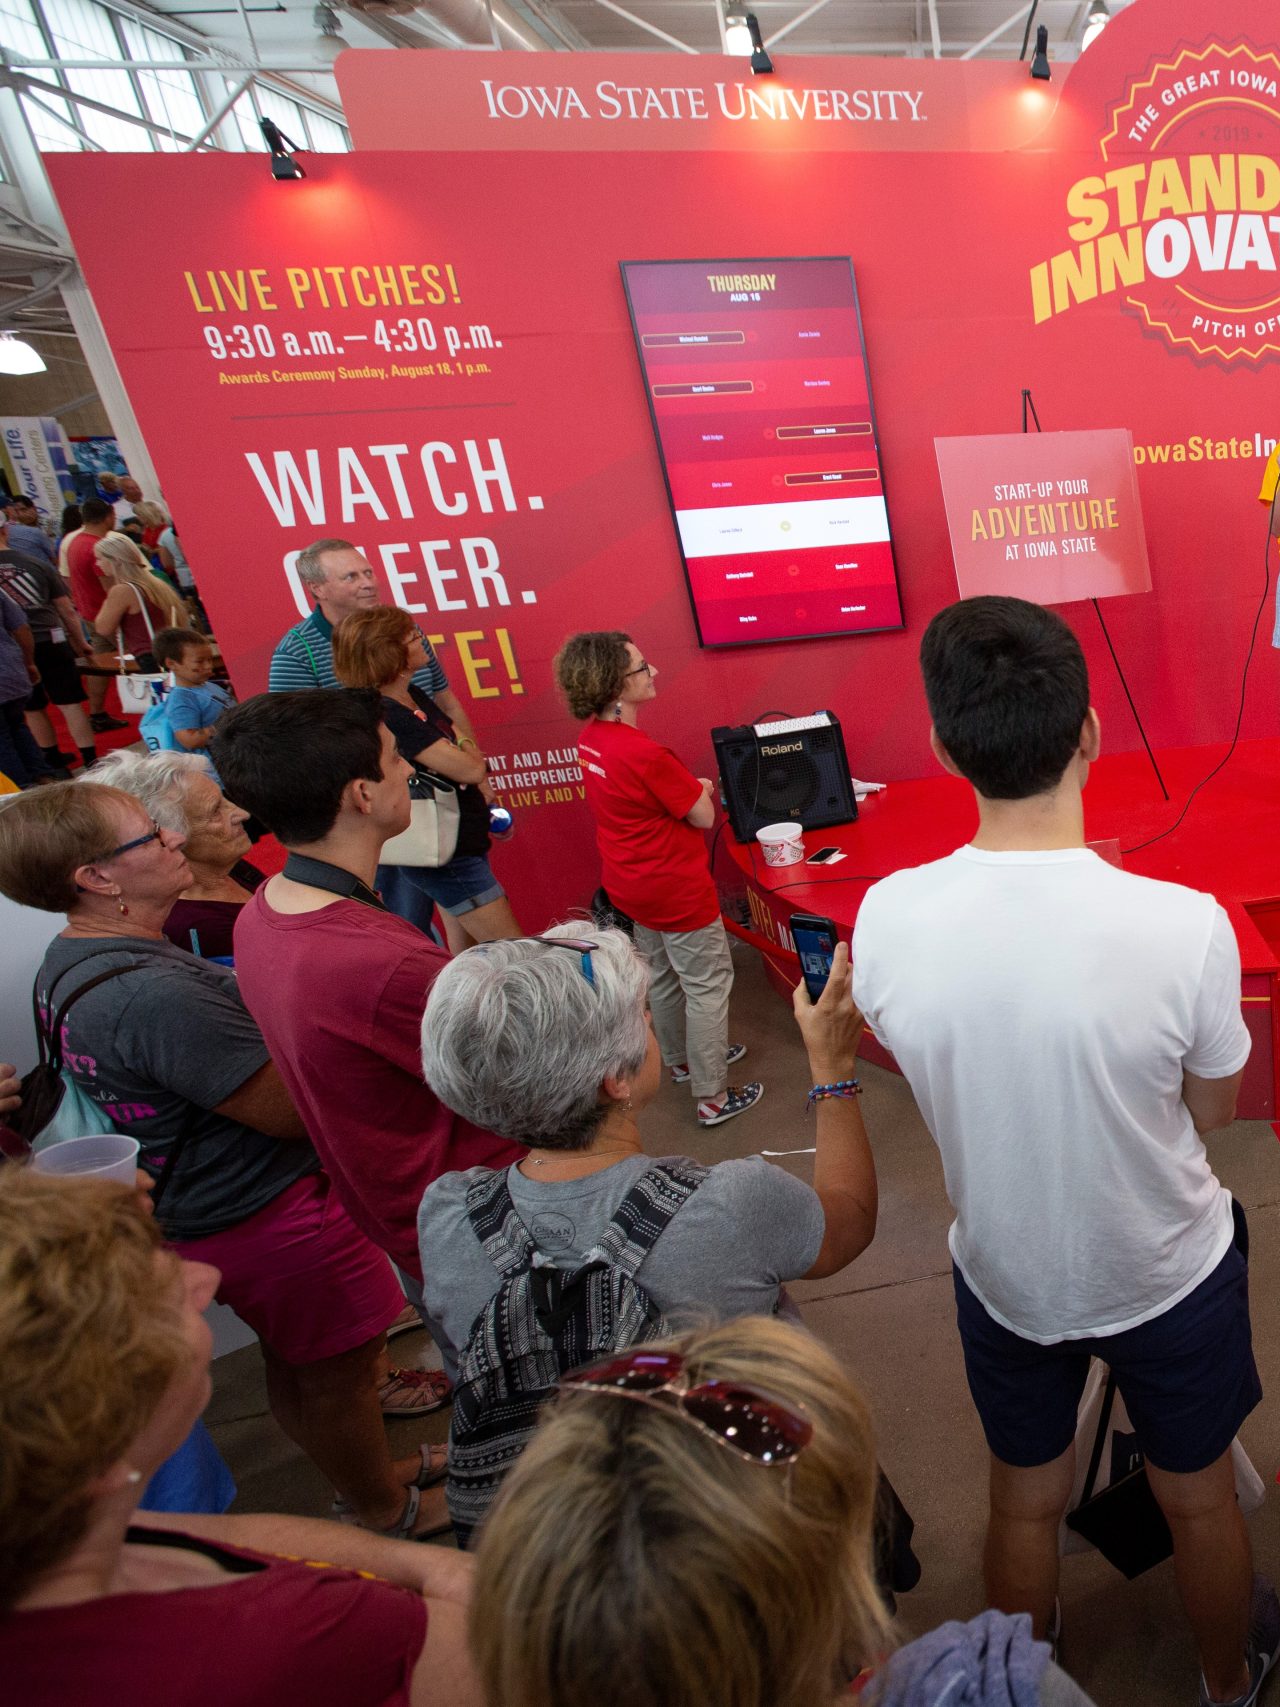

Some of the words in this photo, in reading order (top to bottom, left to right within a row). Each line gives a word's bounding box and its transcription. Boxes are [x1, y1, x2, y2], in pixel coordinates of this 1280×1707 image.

[1128, 103, 1160, 143] THE
[1161, 69, 1221, 107] GREAT
[1229, 69, 1278, 98] IOWA
[184, 267, 278, 313] LIVE
[285, 263, 463, 309] PITCHES!
[707, 273, 776, 293] THURSDAY
[730, 292, 749, 303] AUG
[1191, 313, 1248, 338] PITCH
[203, 323, 276, 360] 9:30
[443, 322, 503, 357] p.m.
[219, 370, 270, 385] Awards
[272, 367, 336, 384] Ceremony
[337, 364, 389, 381] Sunday,
[391, 362, 435, 380] August
[436, 362, 455, 377] 18,
[456, 362, 464, 375] 1
[466, 362, 491, 378] p.m.
[245, 438, 544, 528] WATCH.
[994, 481, 1053, 501] START-UP
[1057, 479, 1089, 496] YOUR
[971, 498, 1120, 541] ADVENTURE
[1005, 544, 1020, 561] AT
[1024, 540, 1058, 559] IOWA
[1061, 536, 1097, 555] STATE
[513, 751, 542, 769] AND
[761, 741, 803, 757] Roland
[509, 790, 542, 808] LIVE
[545, 786, 573, 804] AND
